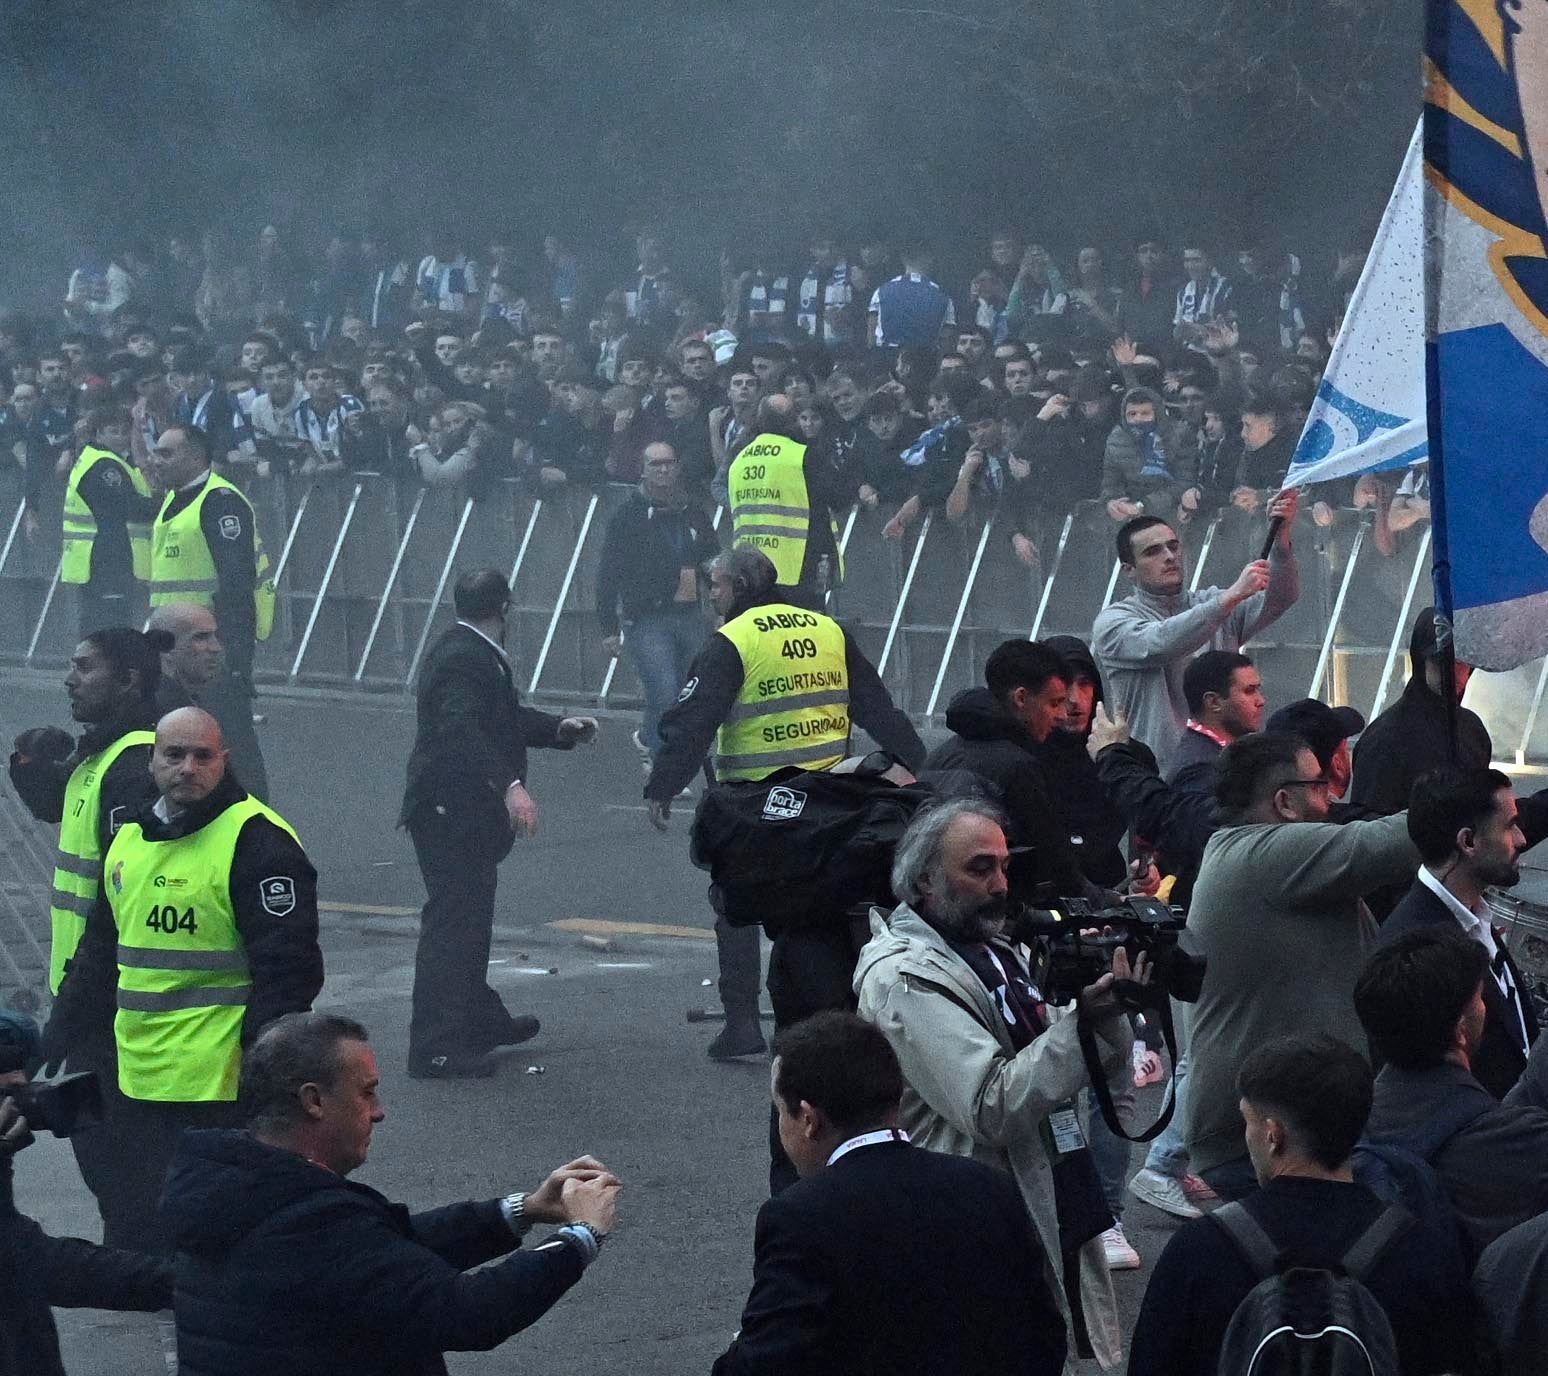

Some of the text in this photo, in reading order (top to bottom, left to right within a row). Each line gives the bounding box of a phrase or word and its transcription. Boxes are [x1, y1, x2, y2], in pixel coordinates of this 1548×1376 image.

[743, 465, 766, 480] 330
[753, 613, 818, 632] SABICO
[781, 638, 817, 660] 409
[758, 671, 842, 697] SEGURTASUNA
[763, 716, 845, 743] SEGURIDAD
[771, 791, 802, 809] porta
[766, 805, 799, 818] brace
[146, 905, 198, 935] 404
